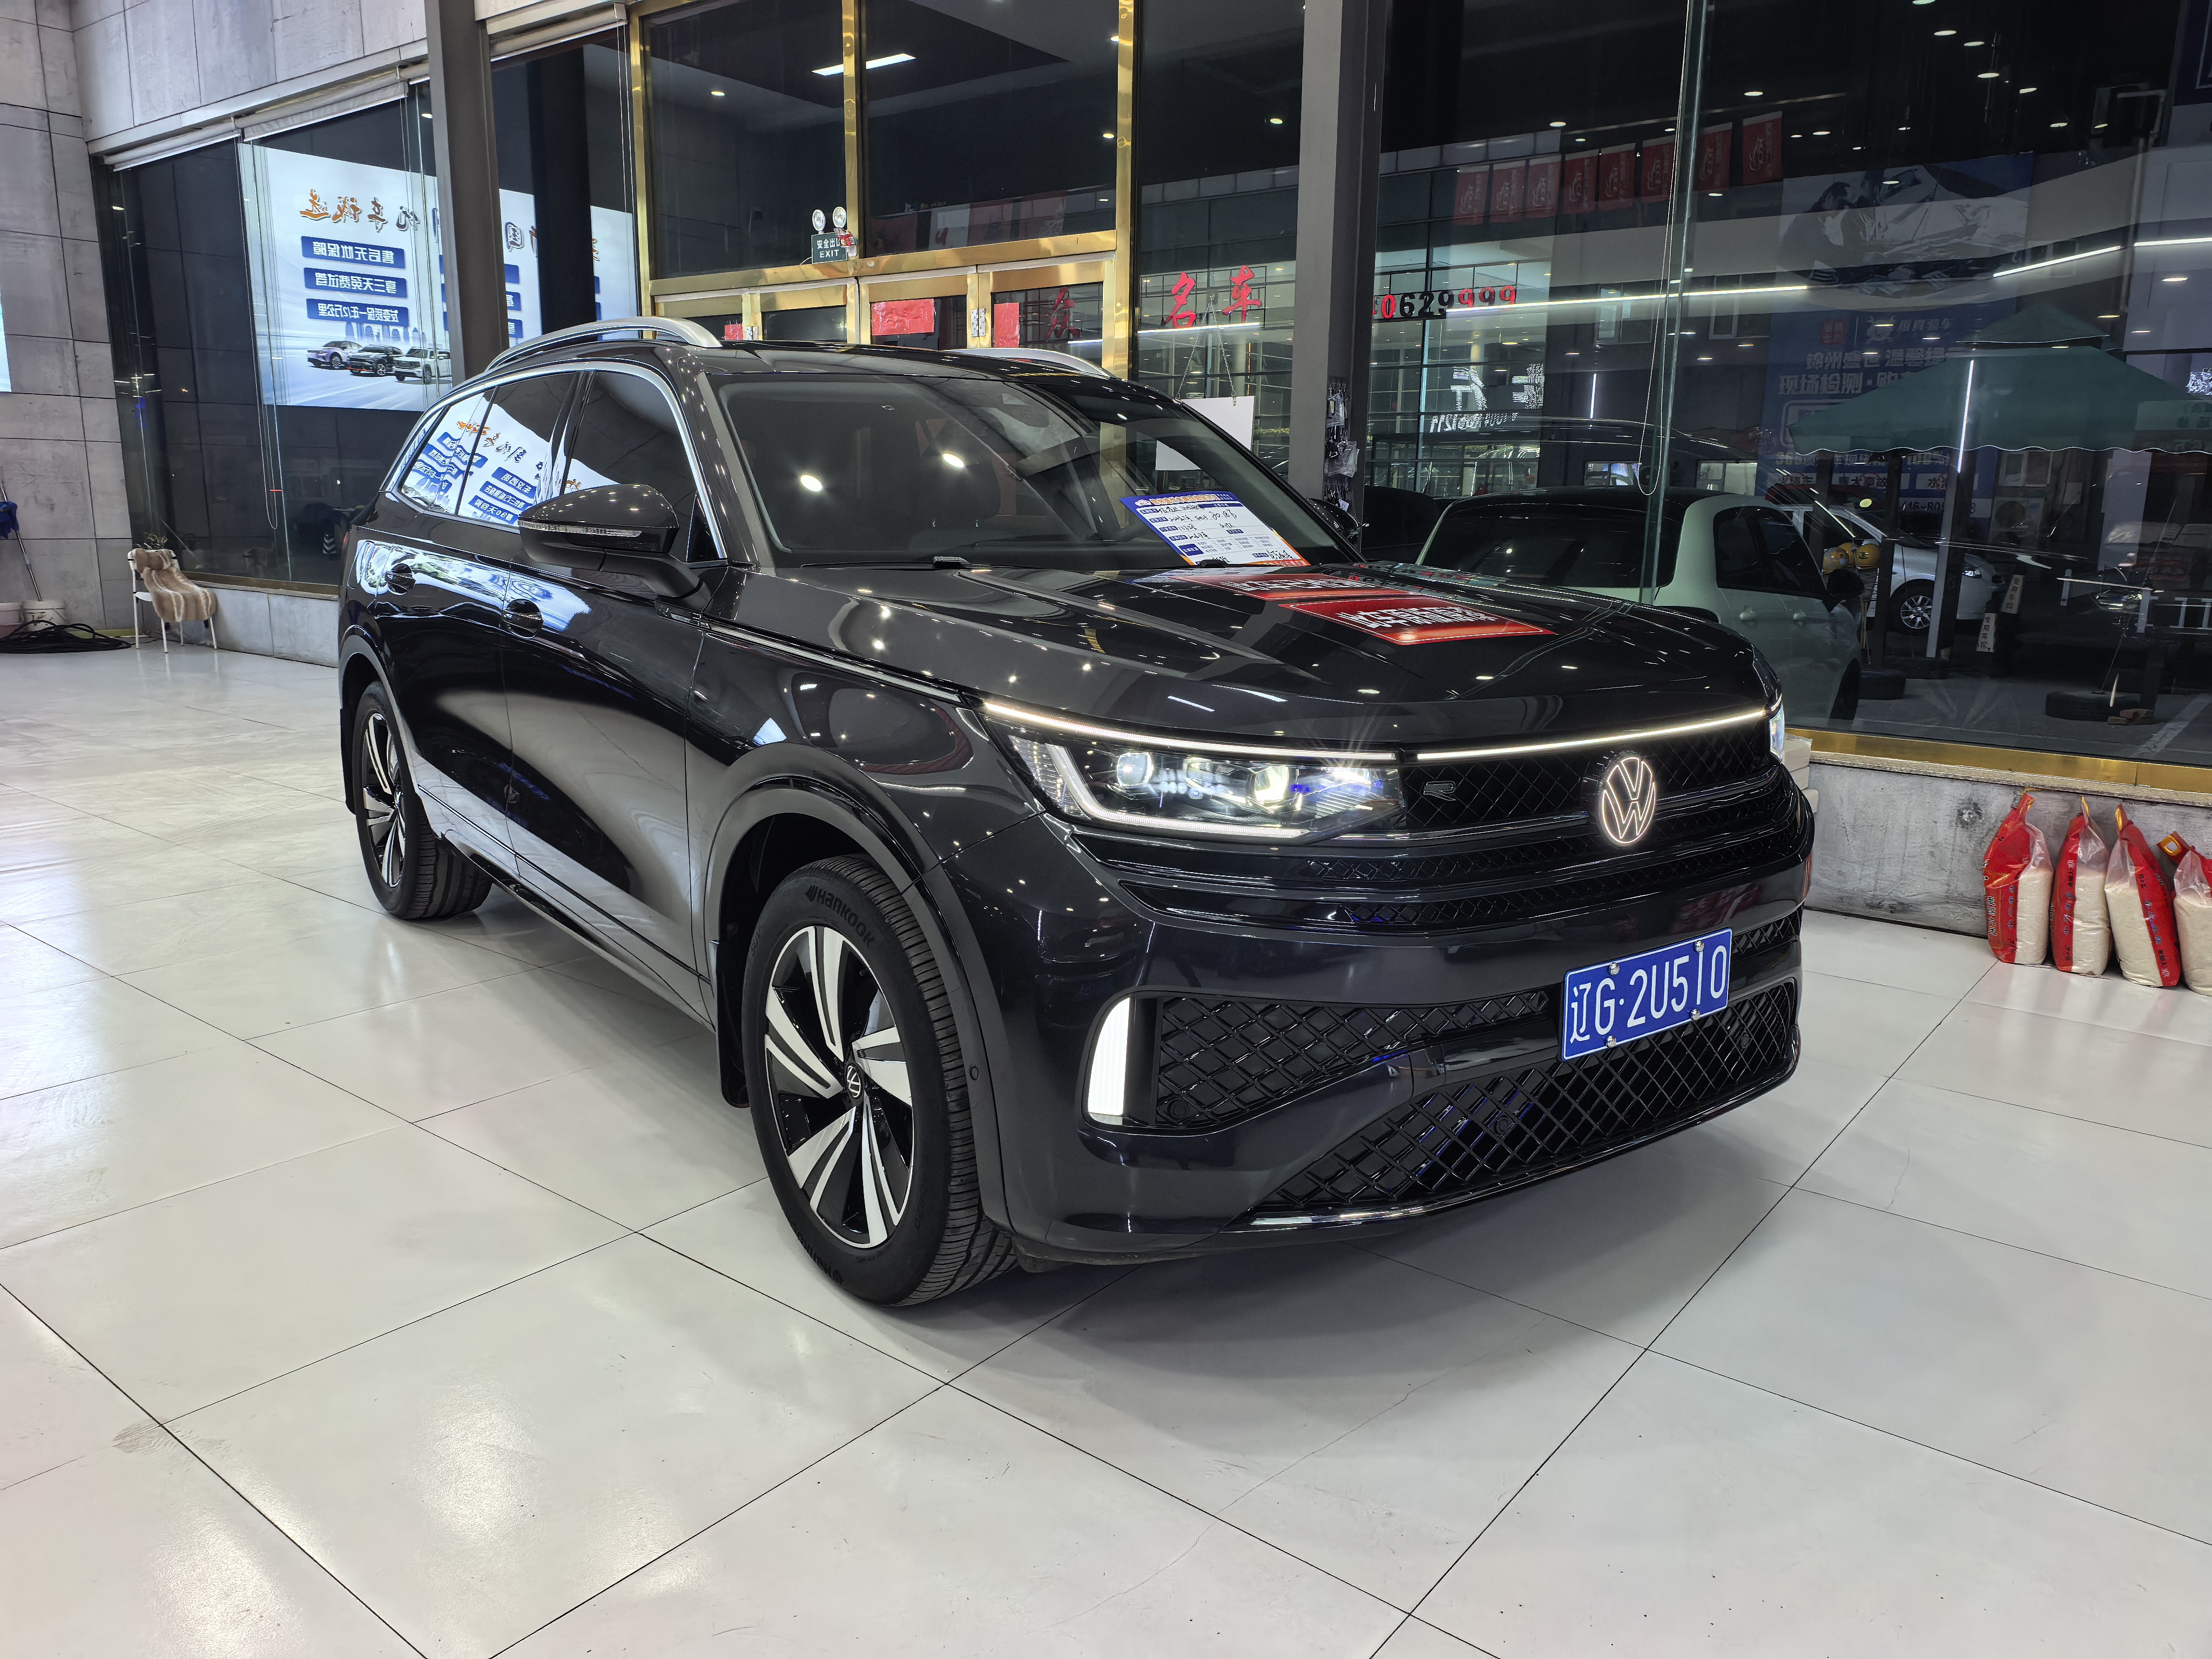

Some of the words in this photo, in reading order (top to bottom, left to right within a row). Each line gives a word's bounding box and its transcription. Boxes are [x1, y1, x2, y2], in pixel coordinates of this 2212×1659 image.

[819, 249, 839, 258] EXIT
[1373, 285, 1517, 319] 0629999
[1336, 606, 1499, 629] 此车原版原漆
